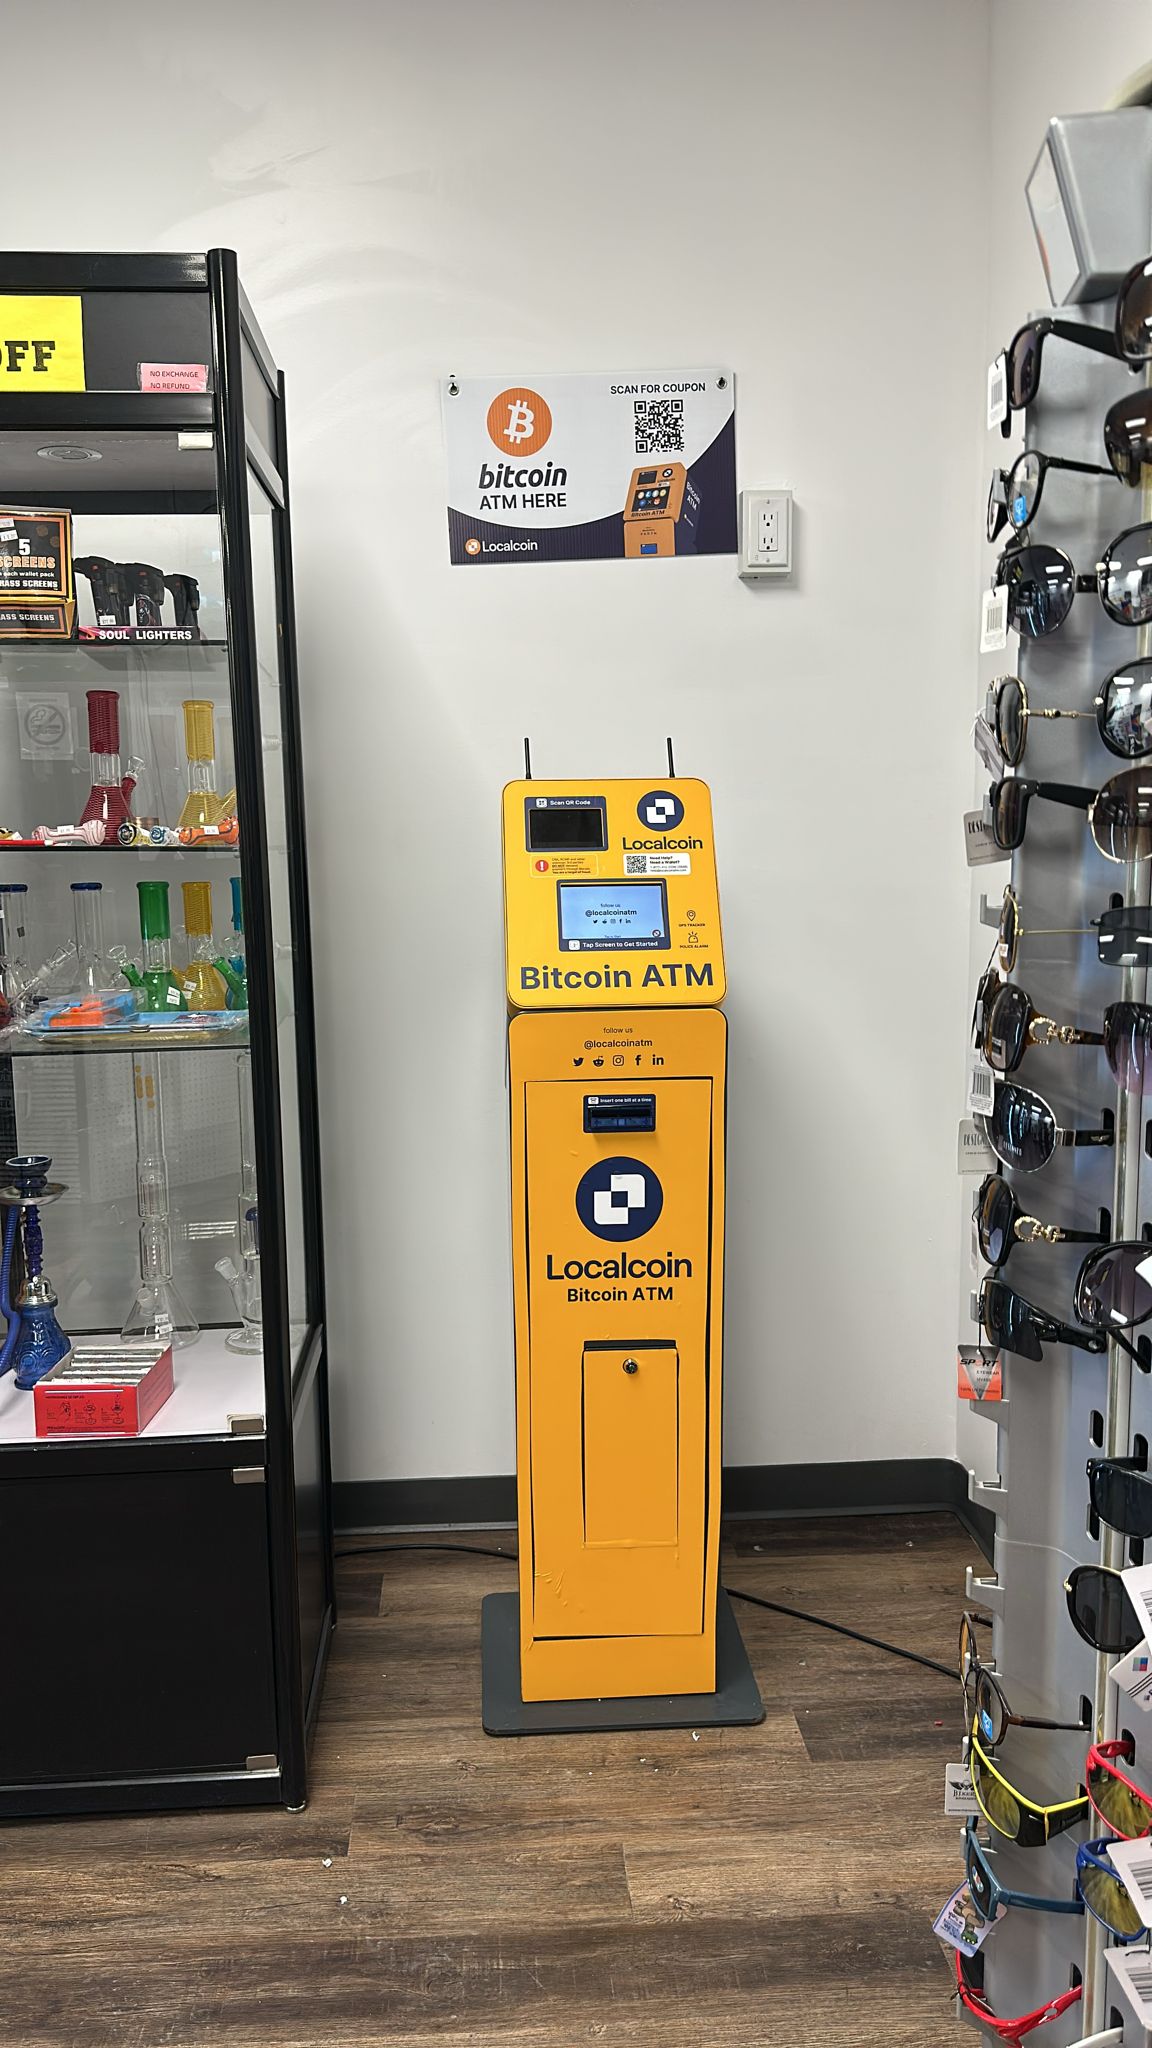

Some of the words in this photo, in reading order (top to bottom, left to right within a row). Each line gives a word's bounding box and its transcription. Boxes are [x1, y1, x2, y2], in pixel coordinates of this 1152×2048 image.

[0, 340, 56, 372] FF
[162, 382, 190, 390] REFUND
[610, 385, 638, 394] SCAN
[641, 384, 660, 393] FOR
[663, 382, 706, 393] COUPON
[478, 461, 568, 490] bitcoin
[479, 494, 518, 510] ATM
[522, 492, 567, 509] HERE
[19, 538, 31, 556] 5
[482, 539, 538, 553] Localcoin
[22, 580, 58, 588] SCREENS
[19, 613, 55, 621] SCREENS
[99, 630, 130, 640] SOUL
[136, 630, 192, 640] LIGHTERS
[622, 836, 703, 850] Localcoin
[520, 964, 632, 990] Bitcoin
[641, 963, 714, 987] ATM
[584, 1039, 653, 1050] @localcoinatm
[547, 1251, 692, 1280] Localcoin
[567, 1287, 627, 1302] Bitcoin
[632, 1287, 673, 1301] ATM
